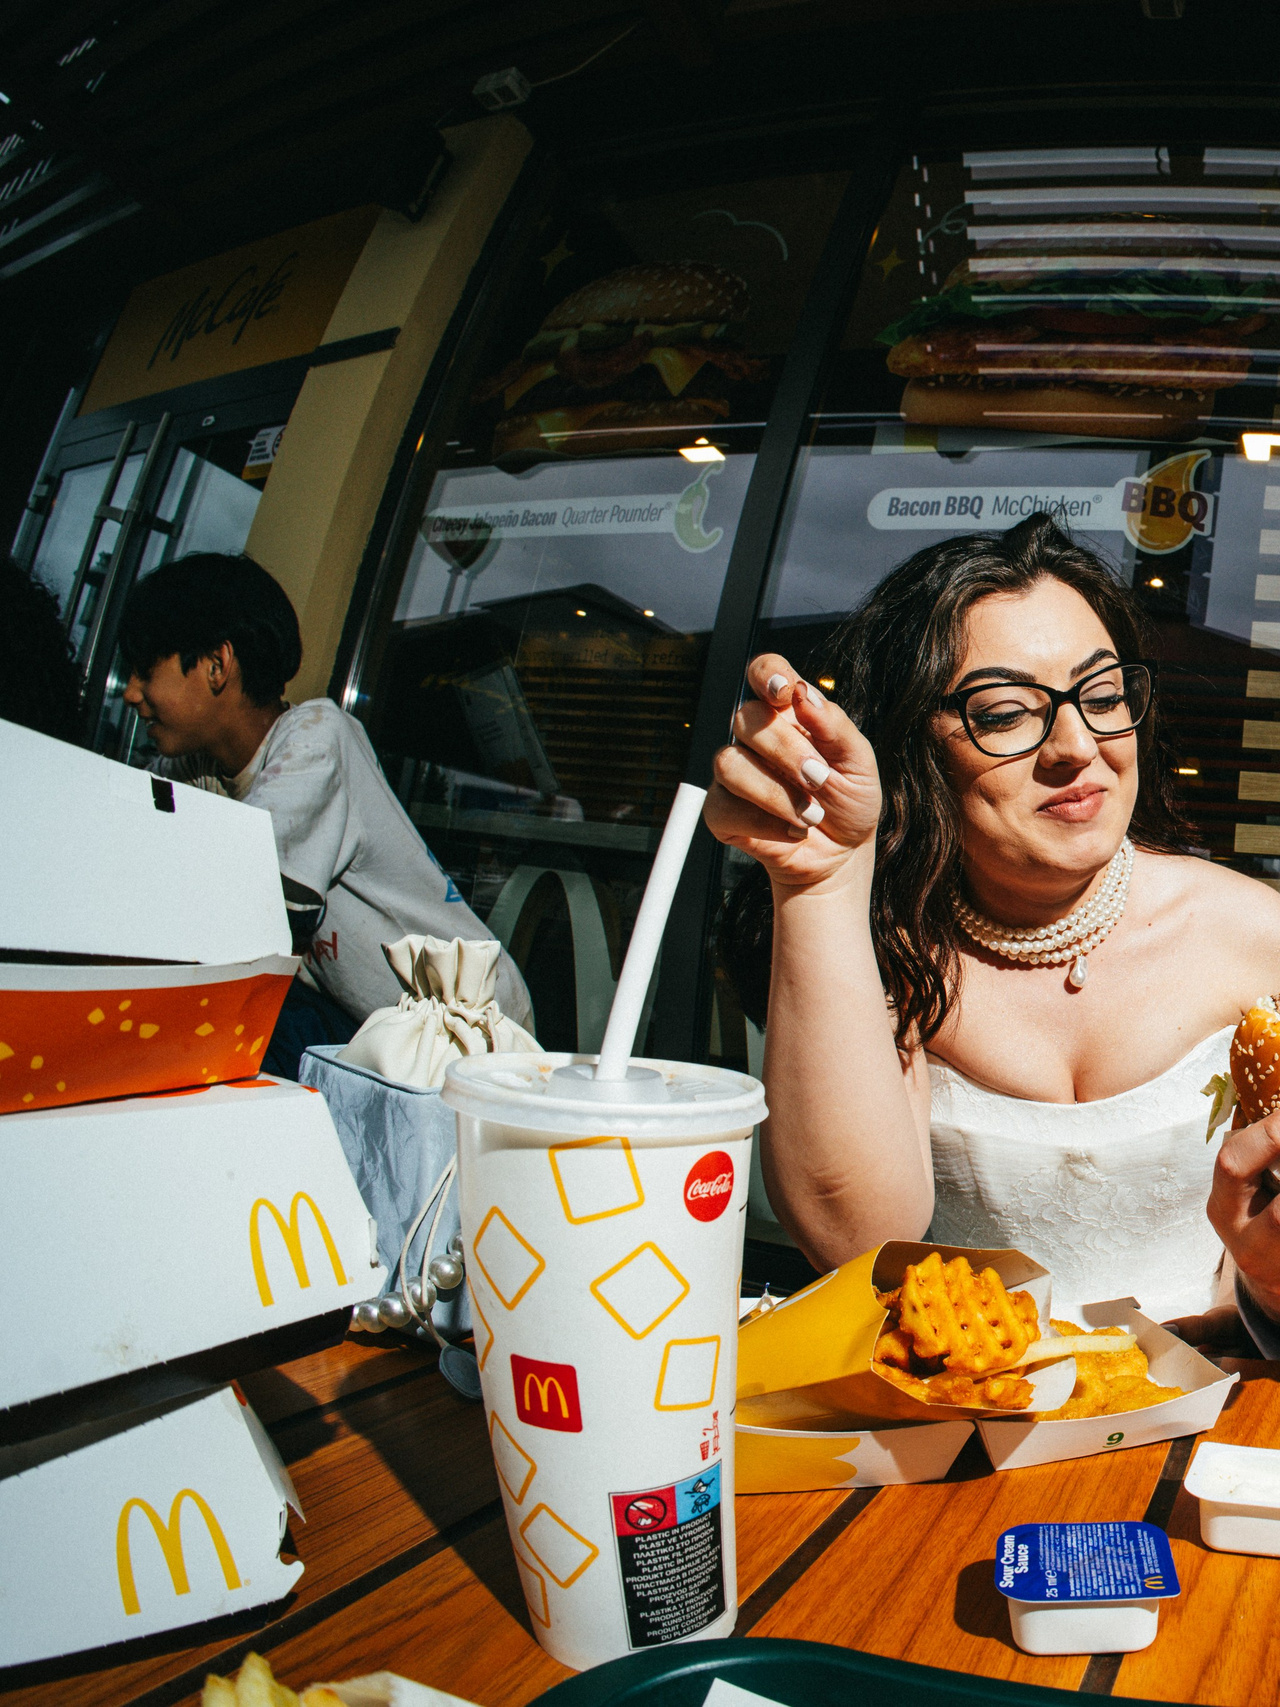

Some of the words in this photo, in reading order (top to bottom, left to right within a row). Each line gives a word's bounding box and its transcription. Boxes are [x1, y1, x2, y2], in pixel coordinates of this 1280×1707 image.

[146, 251, 298, 370] McCafé
[887, 497, 941, 517] Bacon
[943, 495, 983, 520] BBQ
[1121, 481, 1209, 532] BBQ
[432, 517, 468, 535] Cheesy
[469, 511, 518, 531] Jalapeño
[520, 510, 556, 527] Bacon
[561, 508, 608, 527] Quarter
[686, 1172, 732, 1201] Coca-Cola
[635, 1531, 670, 1543] PLASTIC
[681, 1512, 712, 1532] PRODUCT
[639, 1540, 666, 1550] PLAST
[667, 1536, 677, 1544] VE
[1000, 1535, 1015, 1564] Cream
[636, 1555, 670, 1566] PLASTIK
[642, 1561, 675, 1573] PLASTIC
[685, 1544, 711, 1561] PRODUS
[1014, 1543, 1029, 1573] Sauce
[625, 1572, 664, 1583] PRODUKT
[999, 1565, 1015, 1588] Sour
[637, 1584, 675, 1597] PLASTIKA
[649, 1587, 688, 1603] PROIZVOD
[666, 1588, 700, 1605] PLASTIKU
[1046, 1588, 1059, 1598] 25
[640, 1605, 677, 1618] PLASTIKA
[649, 1609, 685, 1623] PRODUKT
[647, 1624, 680, 1637] PRODUIT
